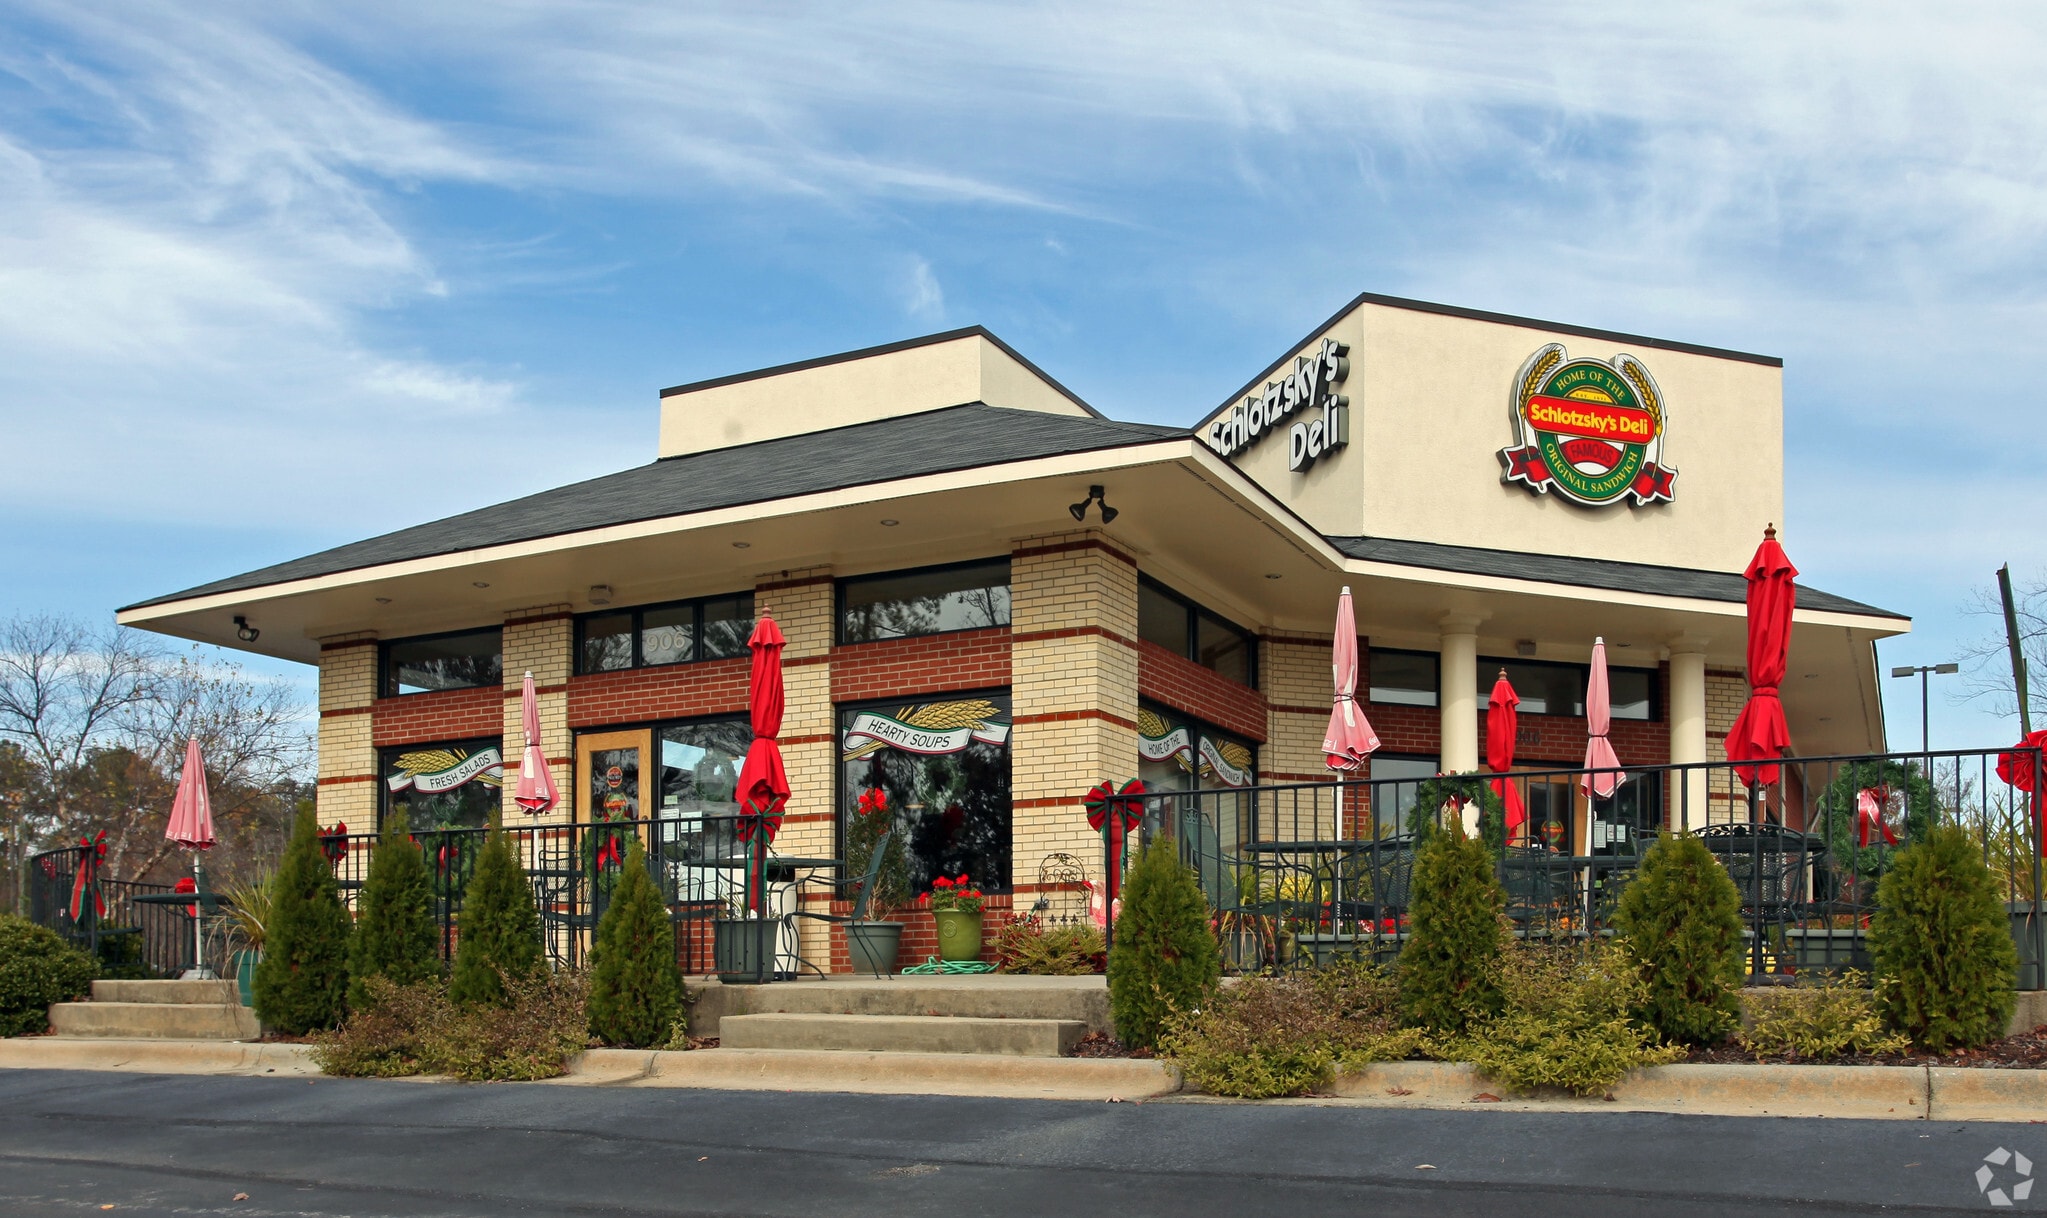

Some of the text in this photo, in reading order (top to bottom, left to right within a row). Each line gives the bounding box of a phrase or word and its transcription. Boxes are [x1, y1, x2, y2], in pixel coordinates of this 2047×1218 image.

[1209, 338, 1341, 457] Schlotzsky's
[1556, 370, 1586, 391] HOME
[1589, 370, 1603, 382] OF
[1606, 377, 1626, 400] THE
[1289, 394, 1342, 473] Deli
[1531, 403, 1648, 435] Schlotzsky's Deli
[1546, 442, 1638, 493] ORIGINAL SANDWICH
[1569, 443, 1614, 464] FAMOUS
[646, 631, 686, 652] 906
[867, 718, 951, 748] HEARTY SOUPS
[1147, 733, 1181, 755] HOME OF THE
[429, 753, 491, 789] FRESH SALADS
[1202, 741, 1240, 783] ORIGINAL SANDWICH
